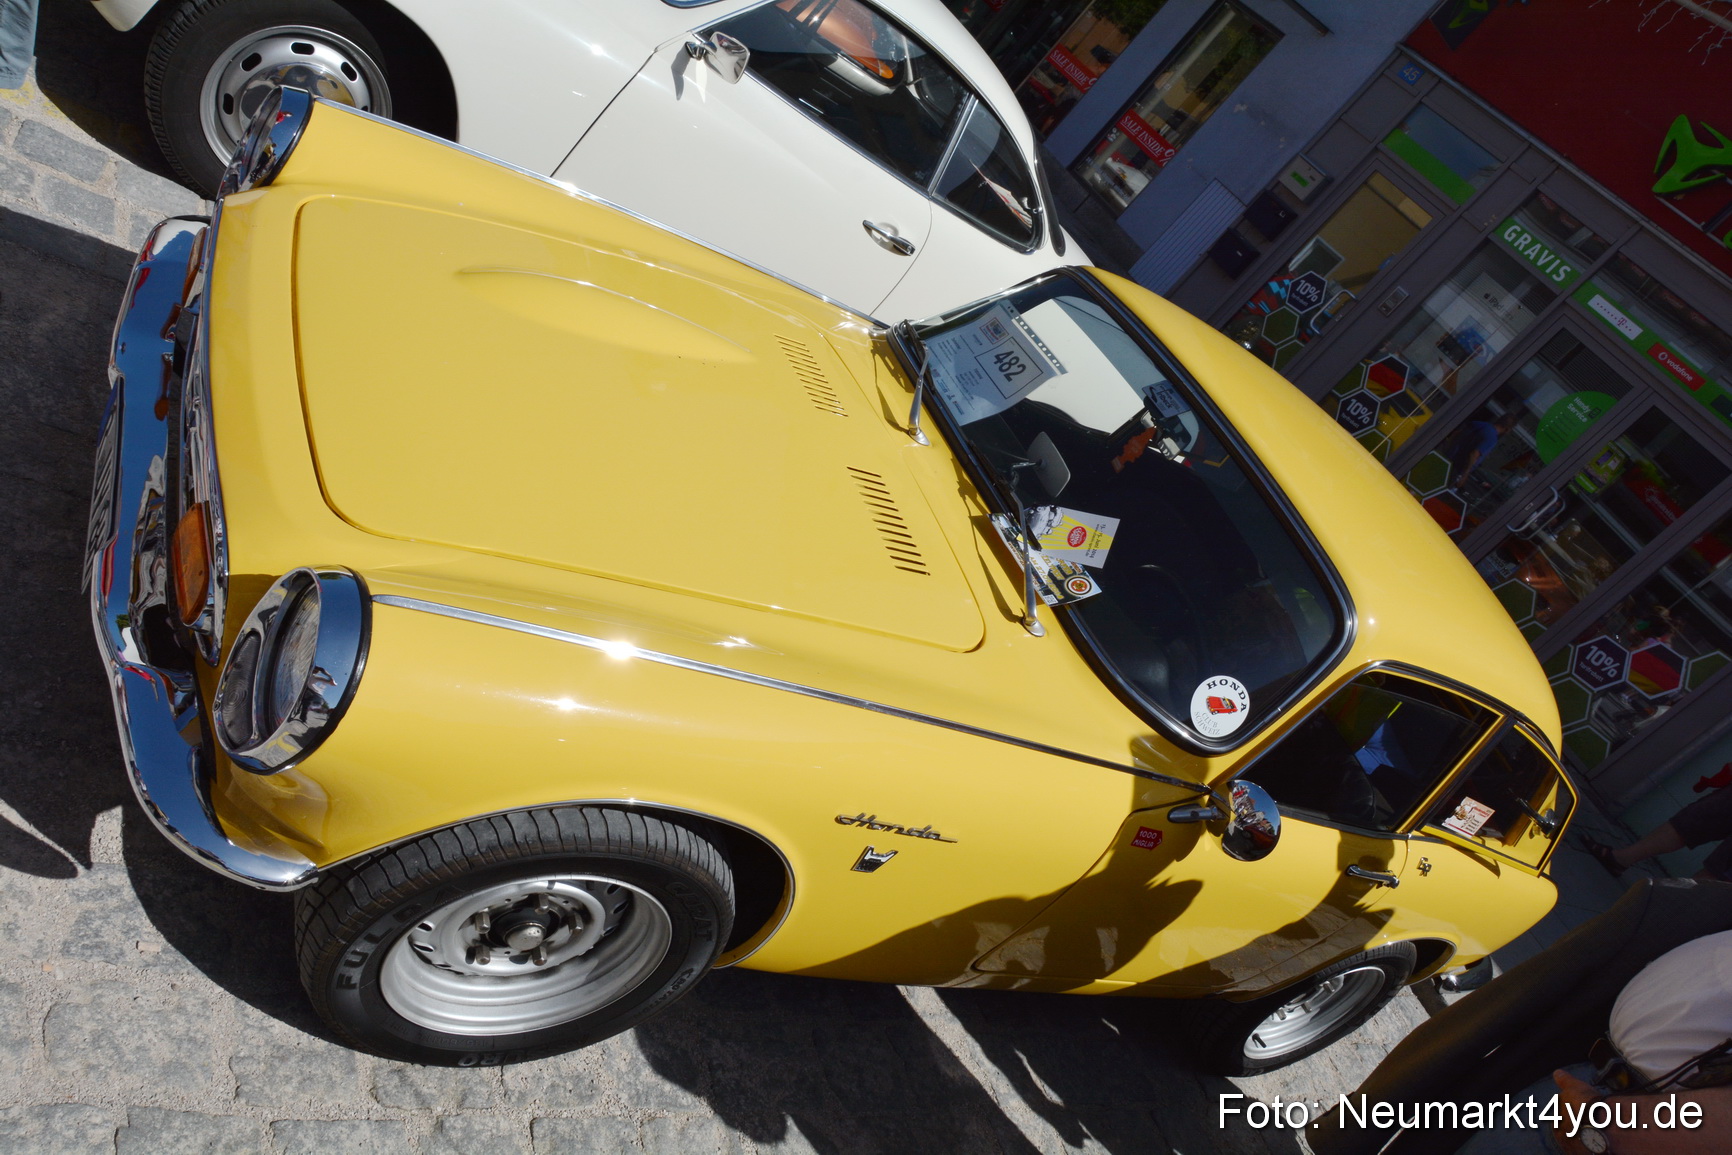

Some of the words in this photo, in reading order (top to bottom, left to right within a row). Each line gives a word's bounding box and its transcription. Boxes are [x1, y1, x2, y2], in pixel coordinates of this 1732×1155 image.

[1050, 48, 1070, 67] SALE
[1066, 60, 1089, 85] INSIDE
[1401, 66, 1421, 82] 45
[1121, 114, 1143, 135] SALE
[1138, 127, 1166, 157] INSIDE
[1503, 224, 1572, 283] GRAVIS
[1295, 277, 1320, 302] 10%
[992, 350, 1027, 382] 482
[1666, 356, 1693, 383] vodafone
[1346, 397, 1372, 425] 10%
[1566, 403, 1588, 423] Service
[1573, 396, 1592, 413] Handy
[1585, 644, 1620, 679] 10%
[1206, 678, 1248, 712] HONDA
[1194, 711, 1221, 736] SCHWEIZ
[1201, 712, 1218, 728] CLUB
[834, 812, 958, 844] Honda
[1138, 829, 1157, 840] 1000
[1133, 837, 1155, 849] MIGLIA
